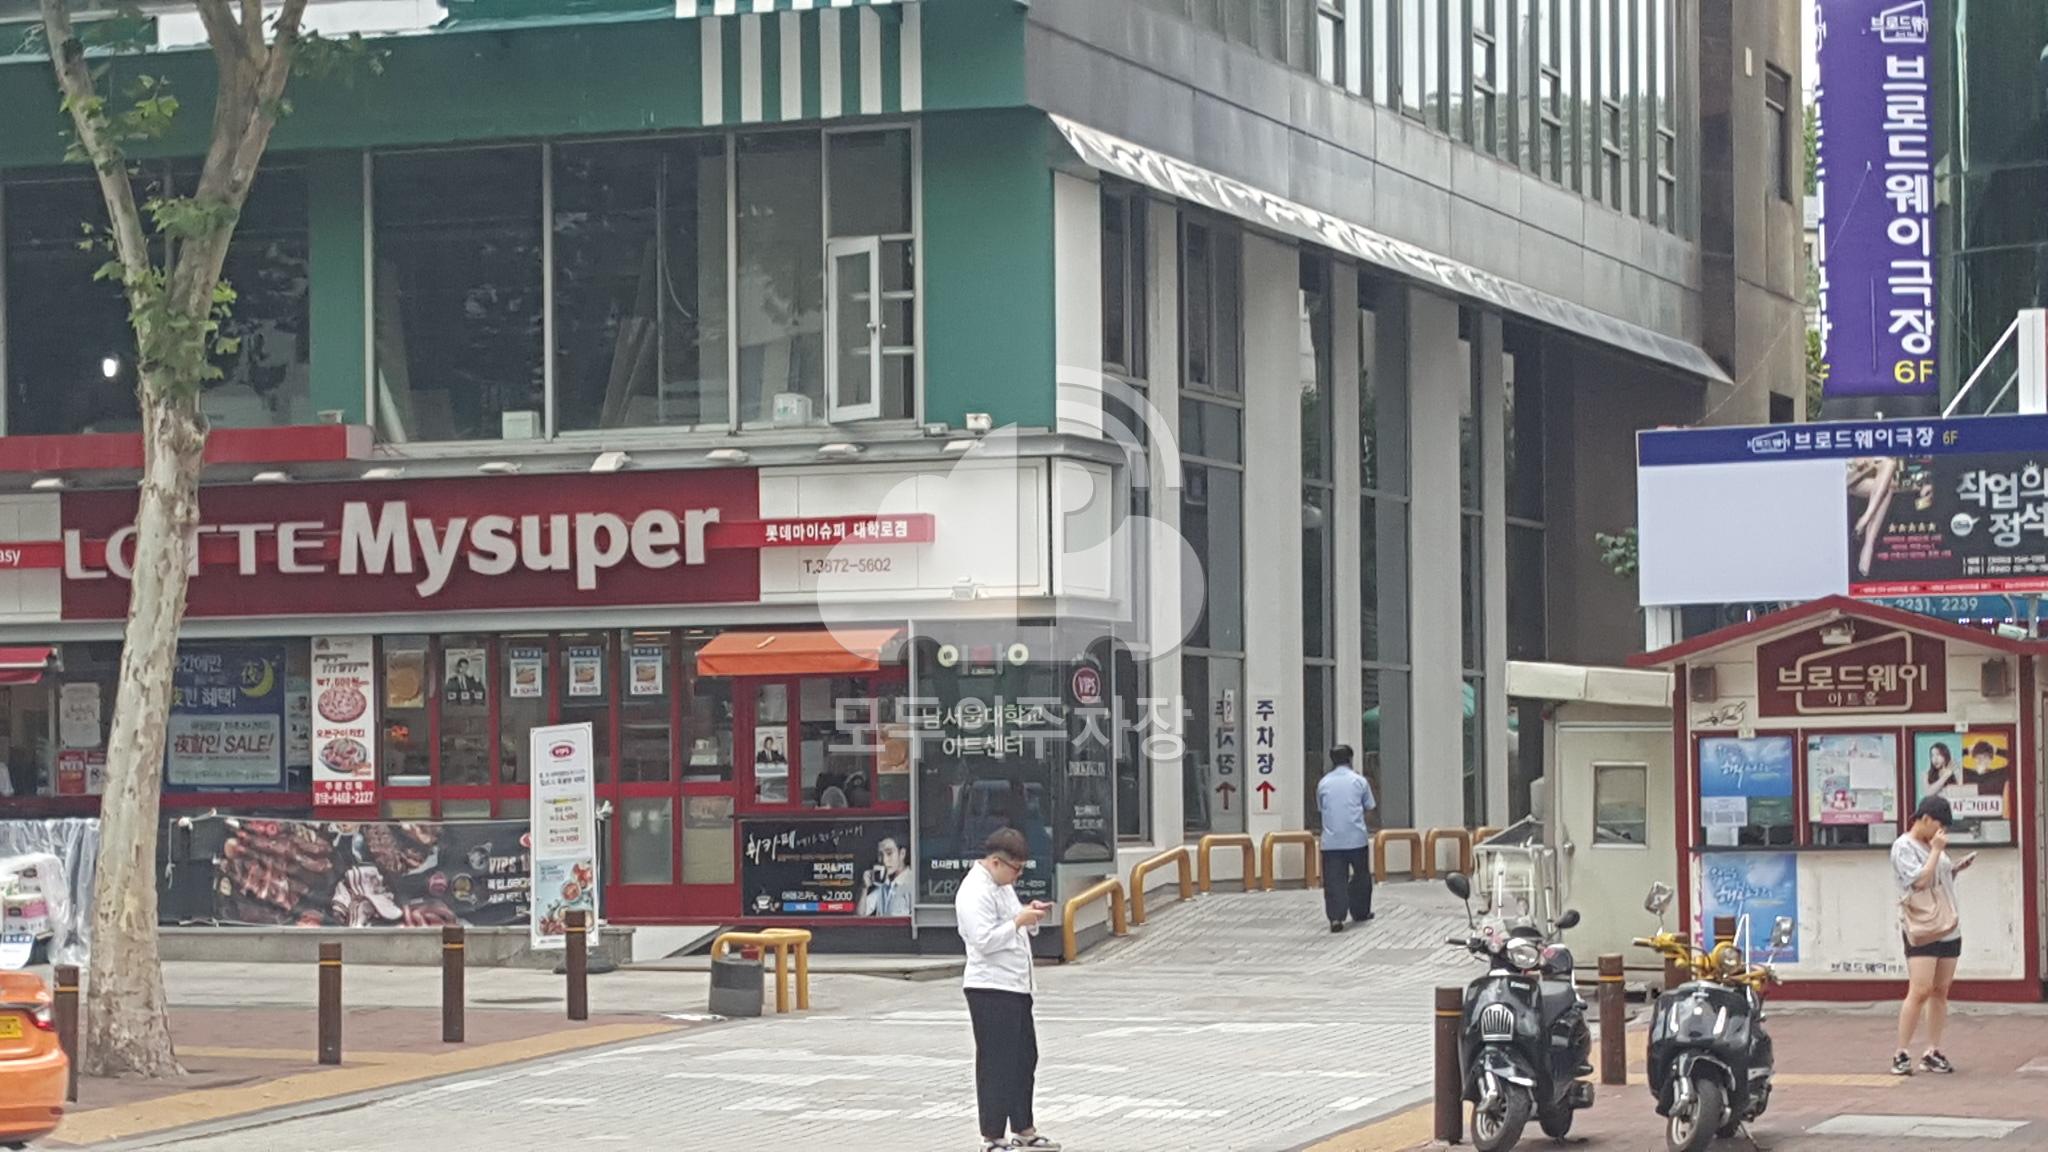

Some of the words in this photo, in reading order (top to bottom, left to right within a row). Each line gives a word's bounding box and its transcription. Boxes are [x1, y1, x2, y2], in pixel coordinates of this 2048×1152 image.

[1883, 55, 1935, 355] 브로드웨이극장
[1894, 360, 1934, 383] 6F
[1794, 427, 1934, 450] 브로드웨이극장
[1942, 431, 1958, 445] 6F
[765, 521, 846, 542] 롯데마이슈퍼
[853, 520, 908, 541] 대학로점
[339, 501, 720, 598] Mysuper
[1777, 664, 1928, 691] 브로드웨이
[922, 703, 1047, 730] 남서울대학교
[224, 732, 274, 753] SALE!
[942, 735, 1024, 758] 아트센터
[1256, 700, 1275, 774] 주차장
